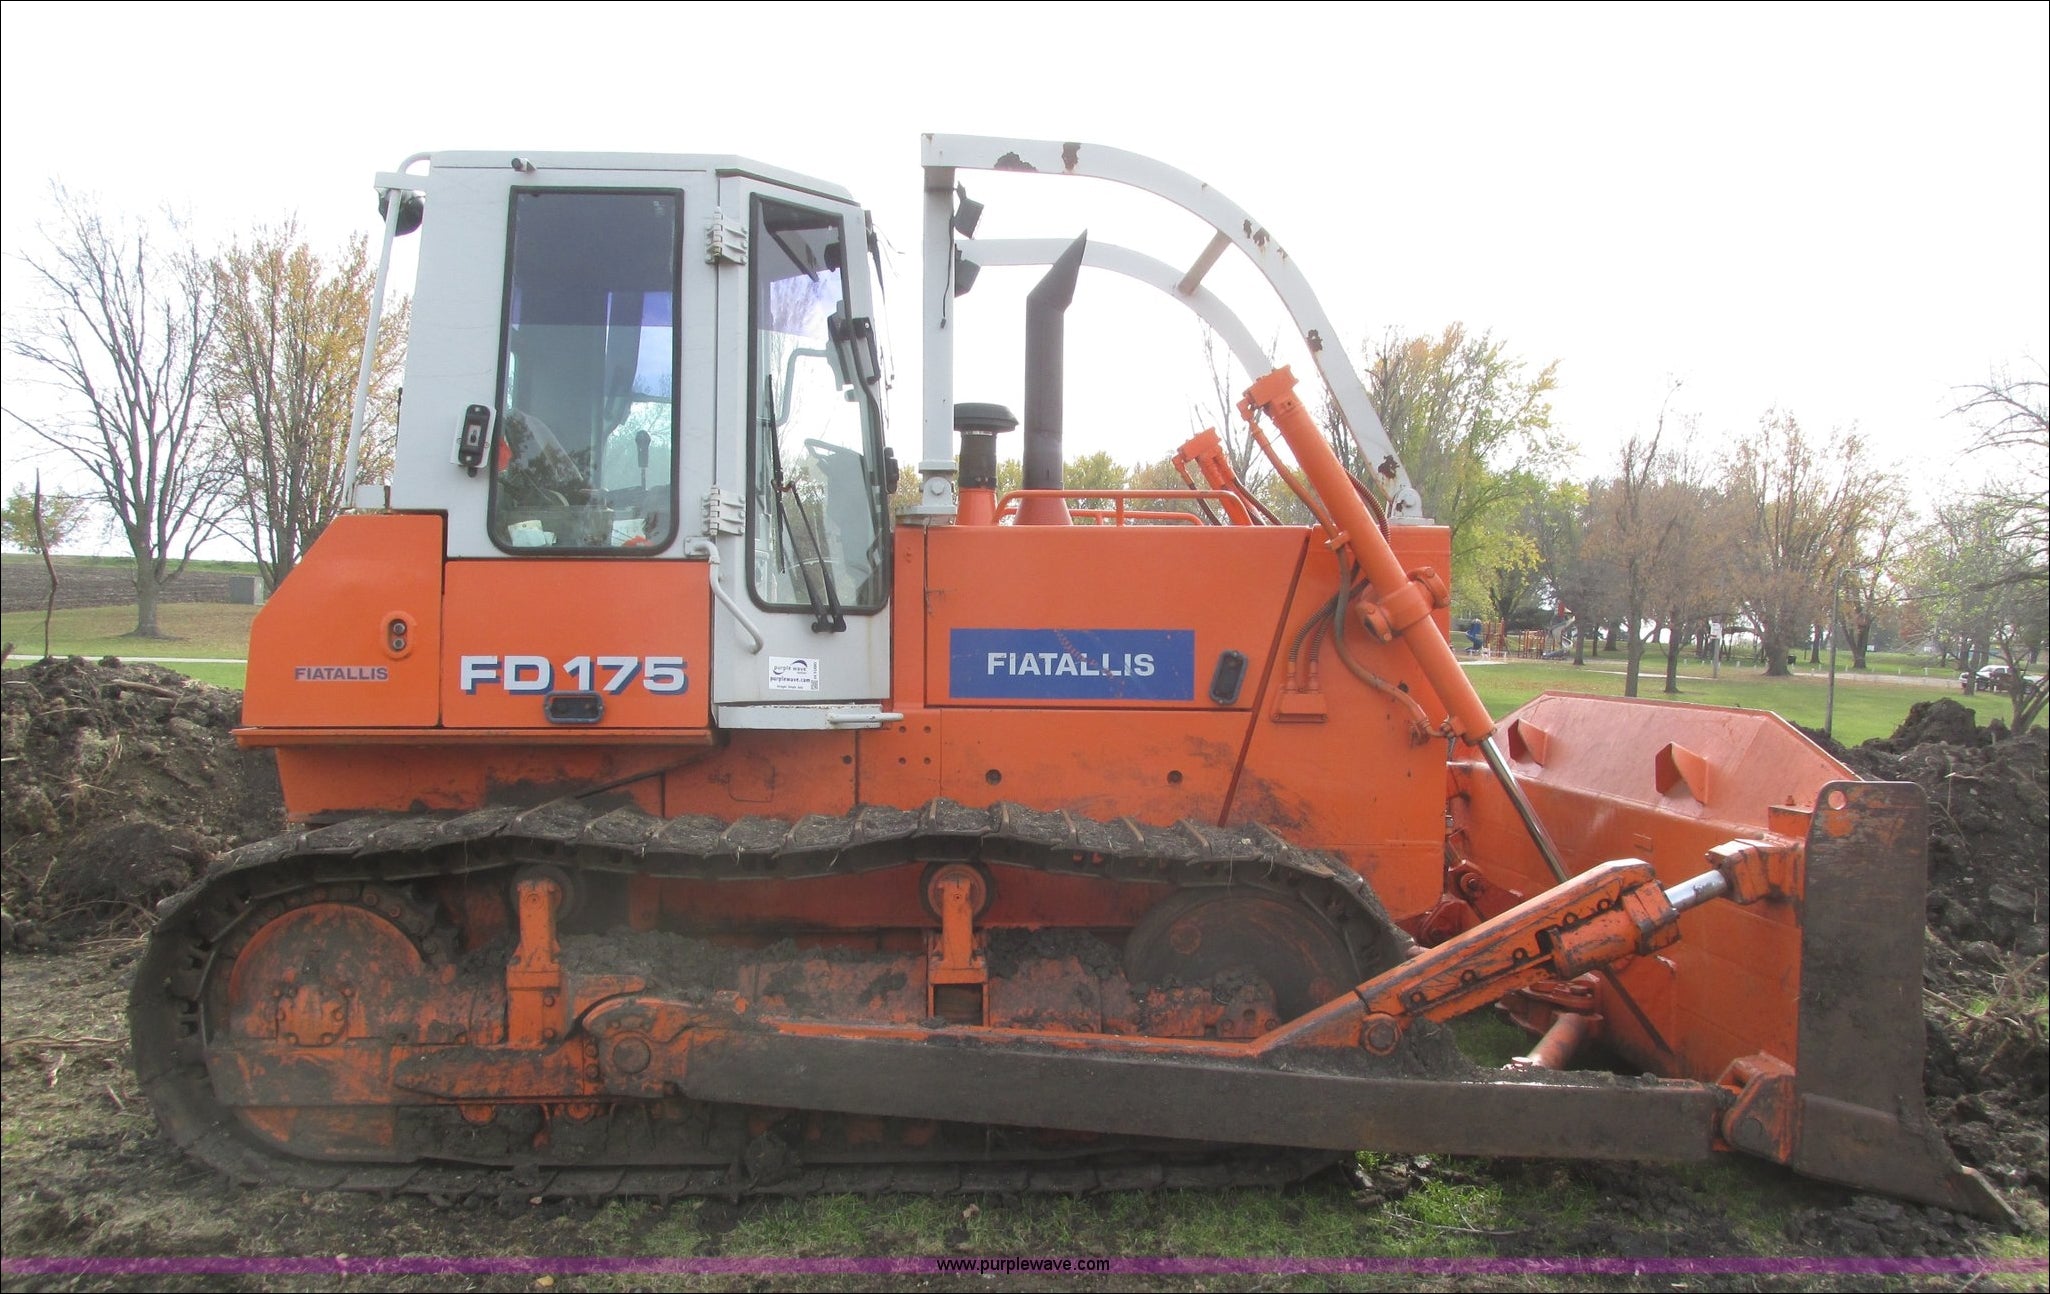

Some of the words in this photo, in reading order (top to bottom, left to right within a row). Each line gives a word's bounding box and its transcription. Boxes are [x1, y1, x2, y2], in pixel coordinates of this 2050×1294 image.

[294, 667, 389, 680] FIATALLIS
[460, 655, 554, 695] FD
[562, 655, 689, 695] 175
[986, 651, 1156, 677] FIATALLIS
